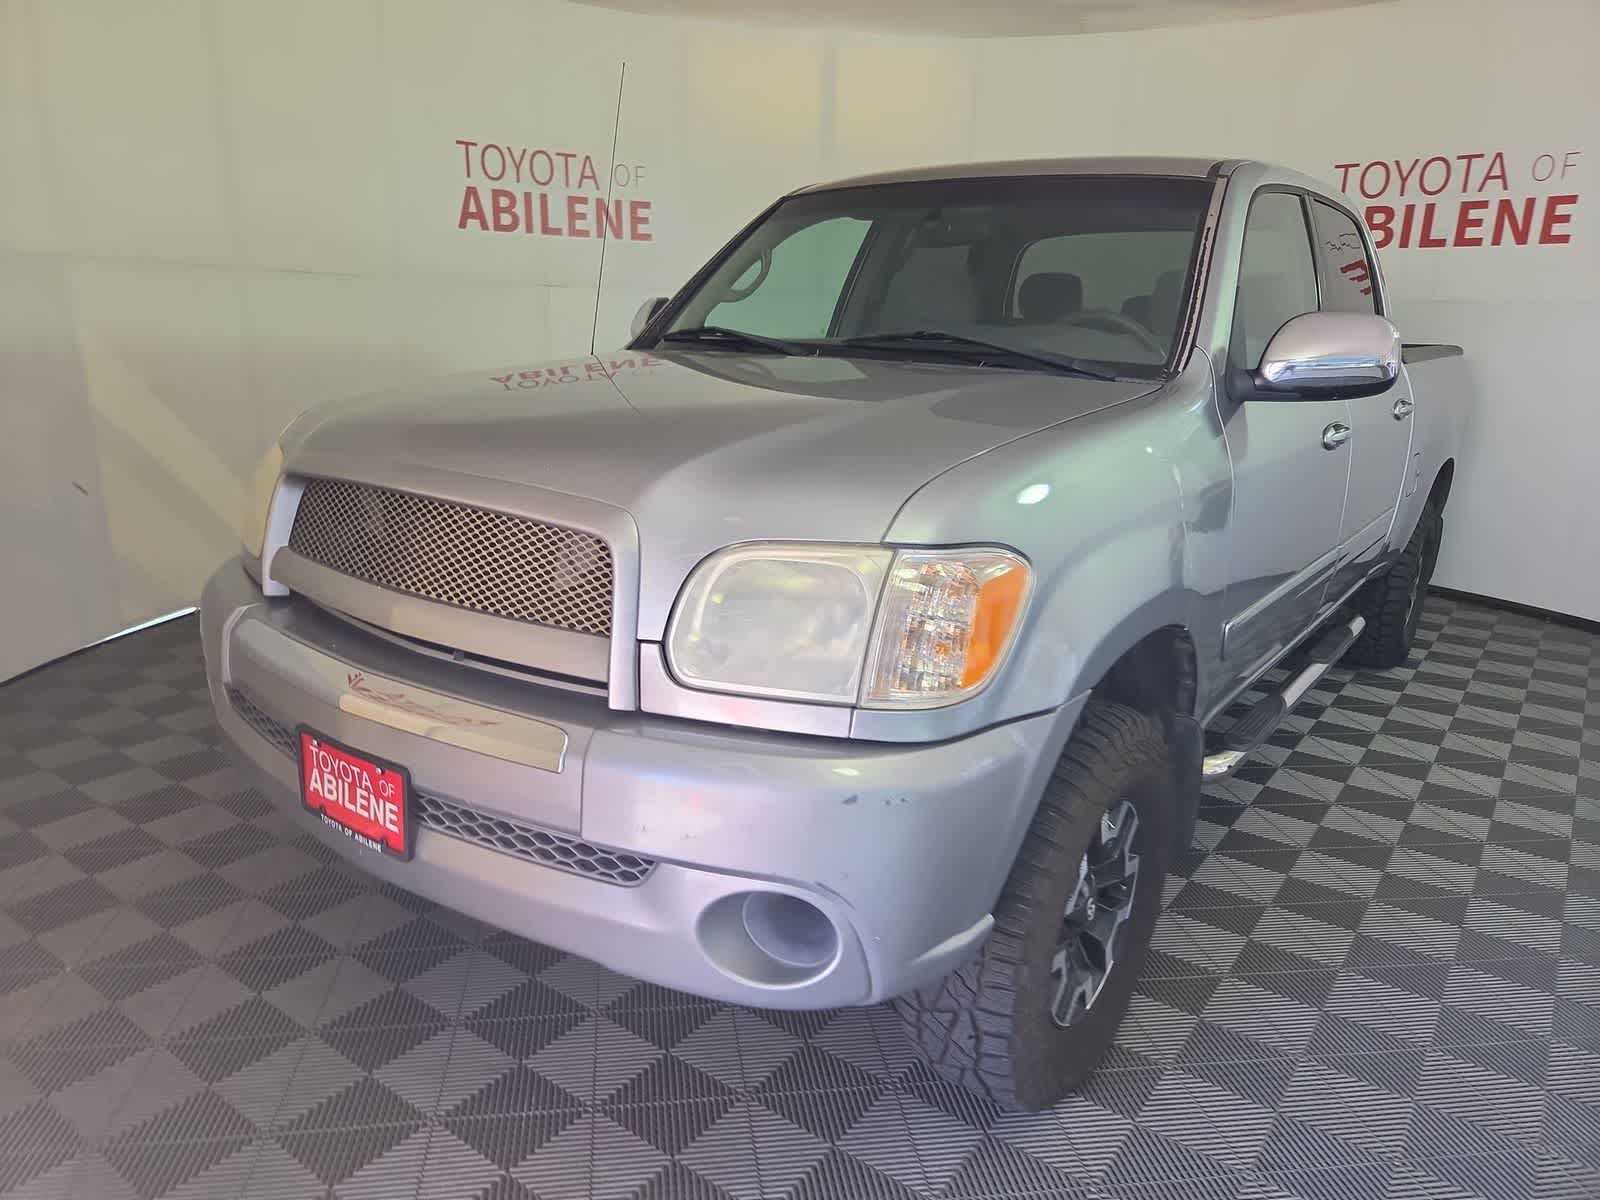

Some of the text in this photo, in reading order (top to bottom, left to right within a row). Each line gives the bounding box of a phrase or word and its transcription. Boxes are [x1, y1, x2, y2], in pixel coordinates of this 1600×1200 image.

[456, 140, 646, 191] TOYOTA OF
[1334, 151, 1582, 199] TOYOTA OF
[458, 186, 653, 241] ABILENE
[1363, 194, 1579, 250] BILENE
[309, 745, 395, 798] TOYOTA OF
[310, 767, 399, 834] ABILENE
[320, 813, 382, 854] TOYOTA OF ABILENE
